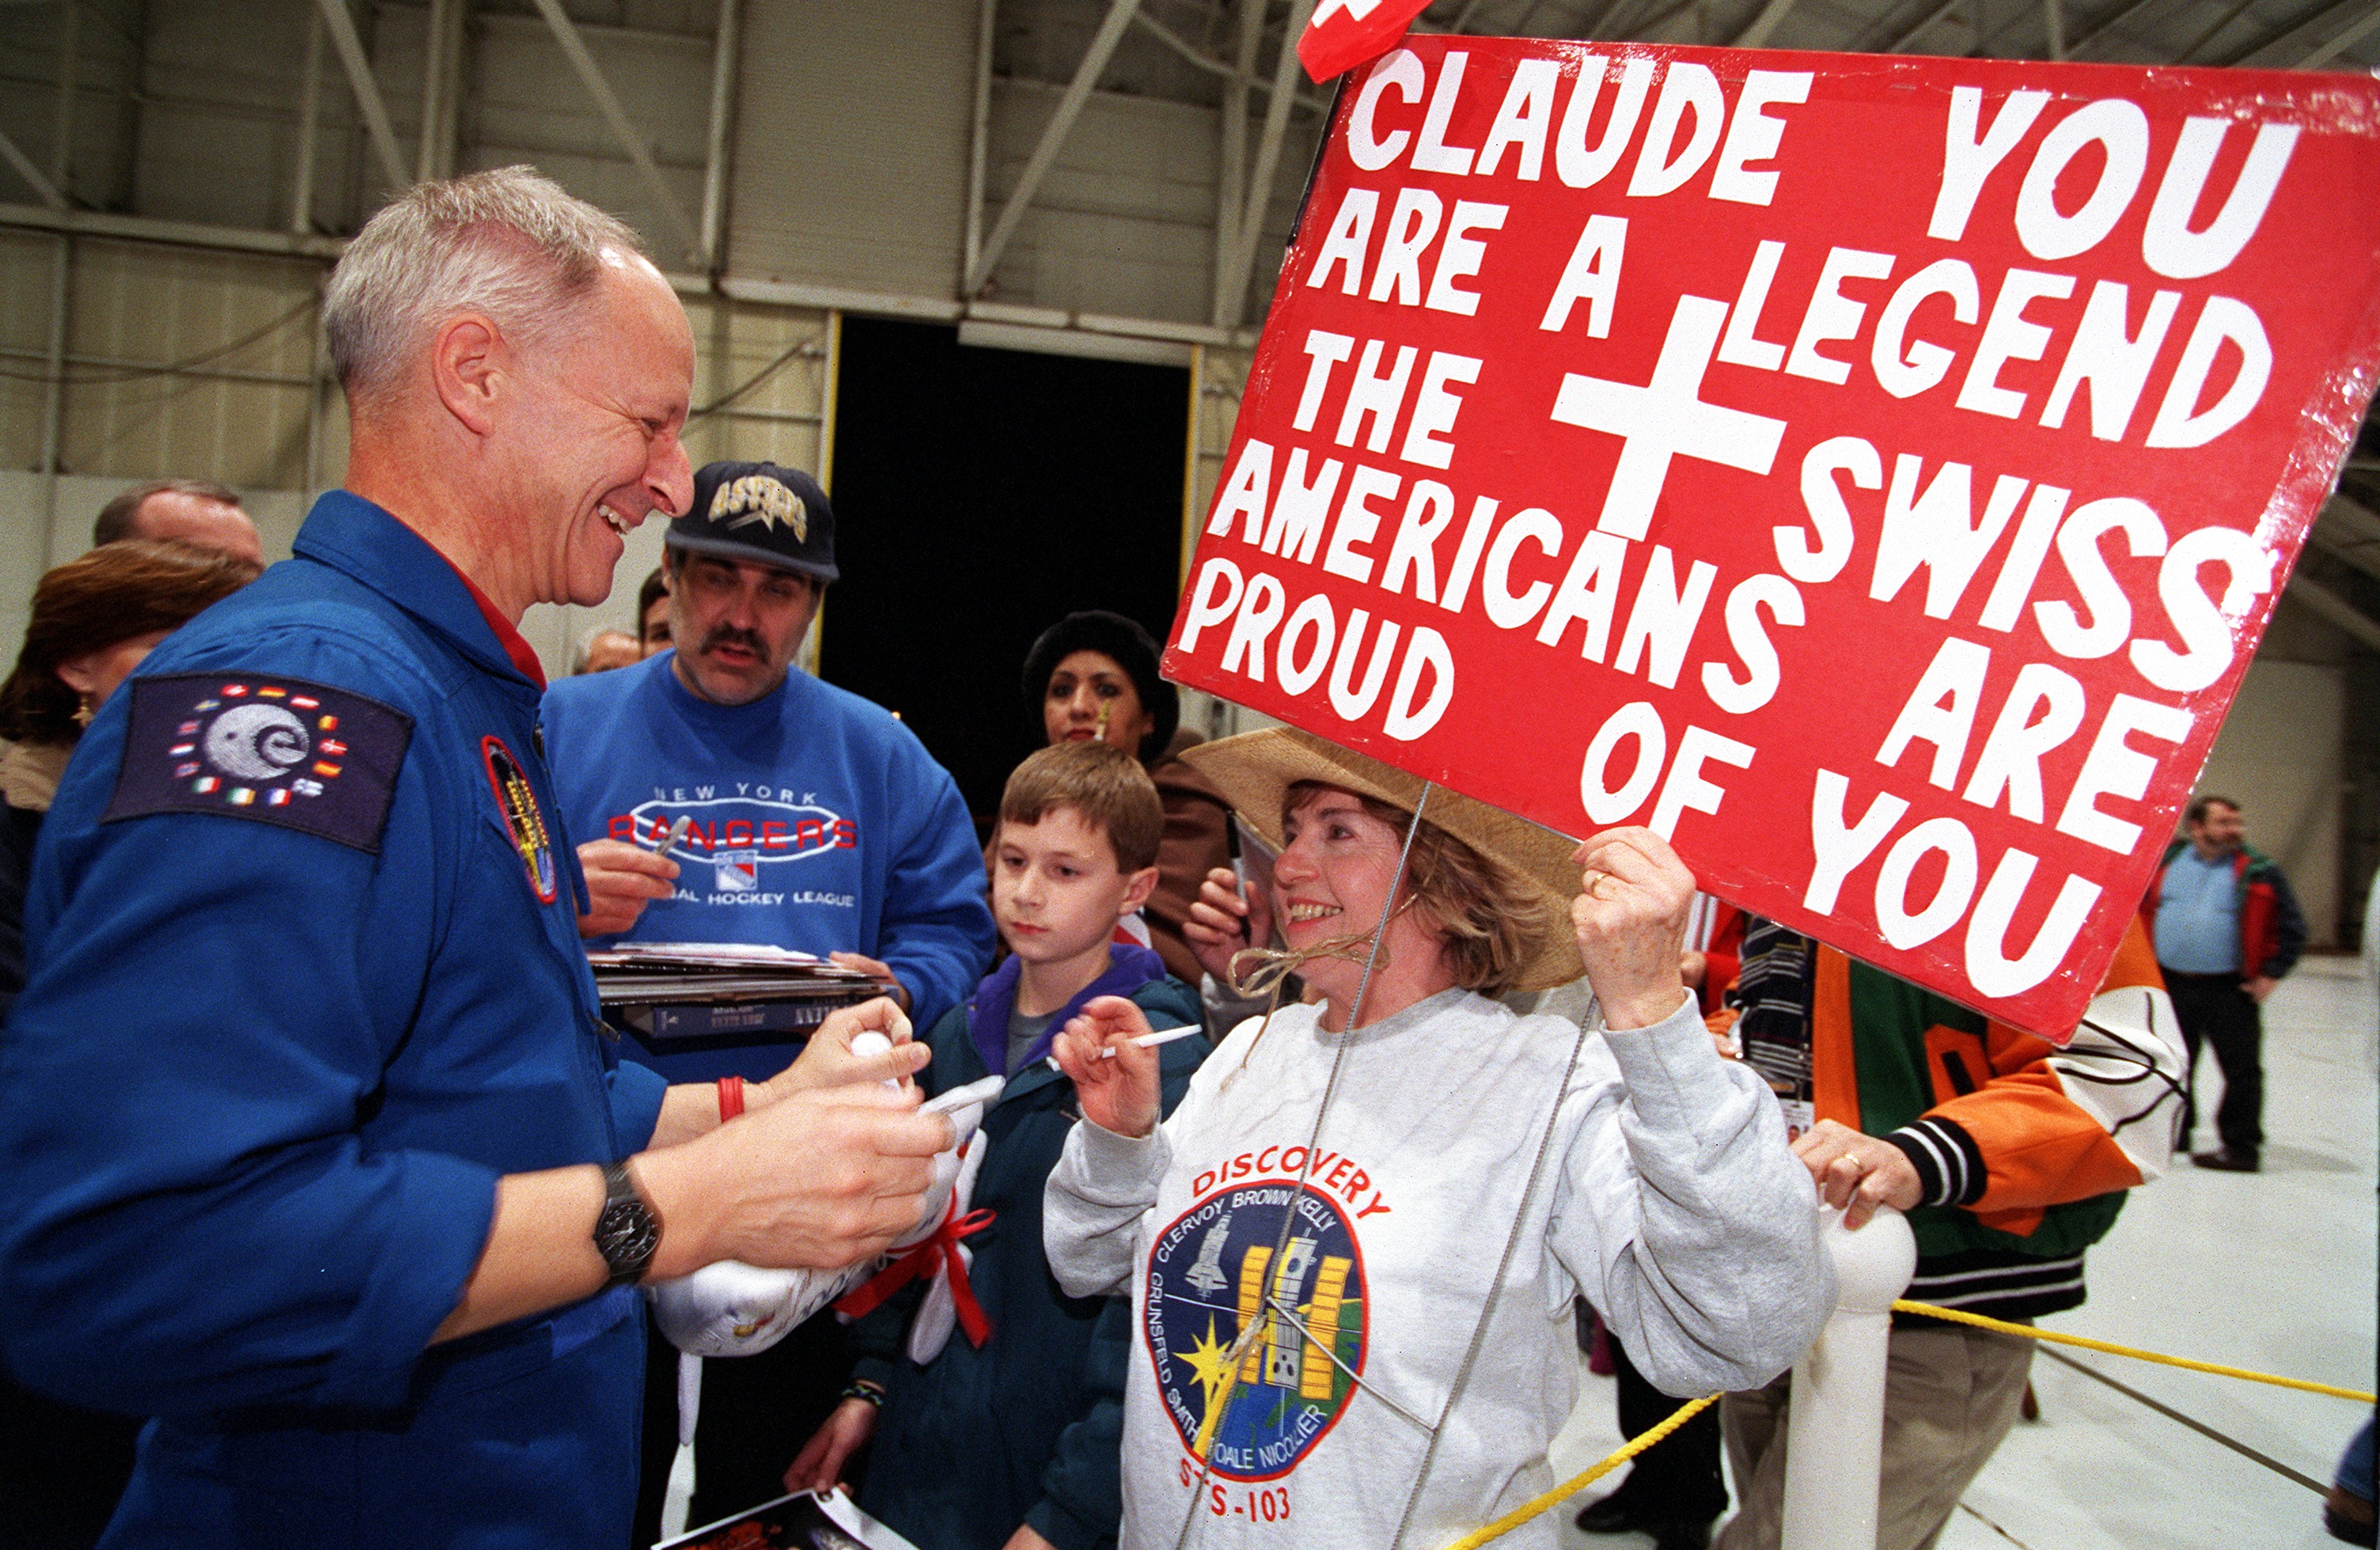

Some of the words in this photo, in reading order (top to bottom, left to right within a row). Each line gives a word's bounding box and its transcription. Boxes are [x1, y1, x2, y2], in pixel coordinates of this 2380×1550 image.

[1347, 48, 1814, 207] CLAUDE
[1927, 86, 2301, 279] YOU
[1306, 188, 1510, 316] ARE
[1538, 214, 1628, 339] A
[1717, 240, 2272, 449] LEGEND
[1292, 329, 1484, 469] THE
[1773, 436, 2272, 692] SWISS
[1207, 438, 1805, 714] AMERICANS
[1874, 636, 2196, 855] ARE
[608, 814, 856, 851] RANGERS
[654, 785, 715, 802] NEW
[737, 783, 817, 805] YORK
[1178, 558, 1454, 741] PROUD
[1581, 702, 1757, 843] OF
[1803, 768, 2102, 998] YOU
[708, 893, 784, 905] HOCKEY
[793, 891, 854, 908] LEAGUE
[1157, 1198, 1225, 1263] CLERVOY
[1232, 1189, 1294, 1208] BROWN
[1296, 1195, 1336, 1232] KELLY
[1193, 1145, 1391, 1219] DISCOVERY
[1147, 1272, 1172, 1384] GRUNSFELD
